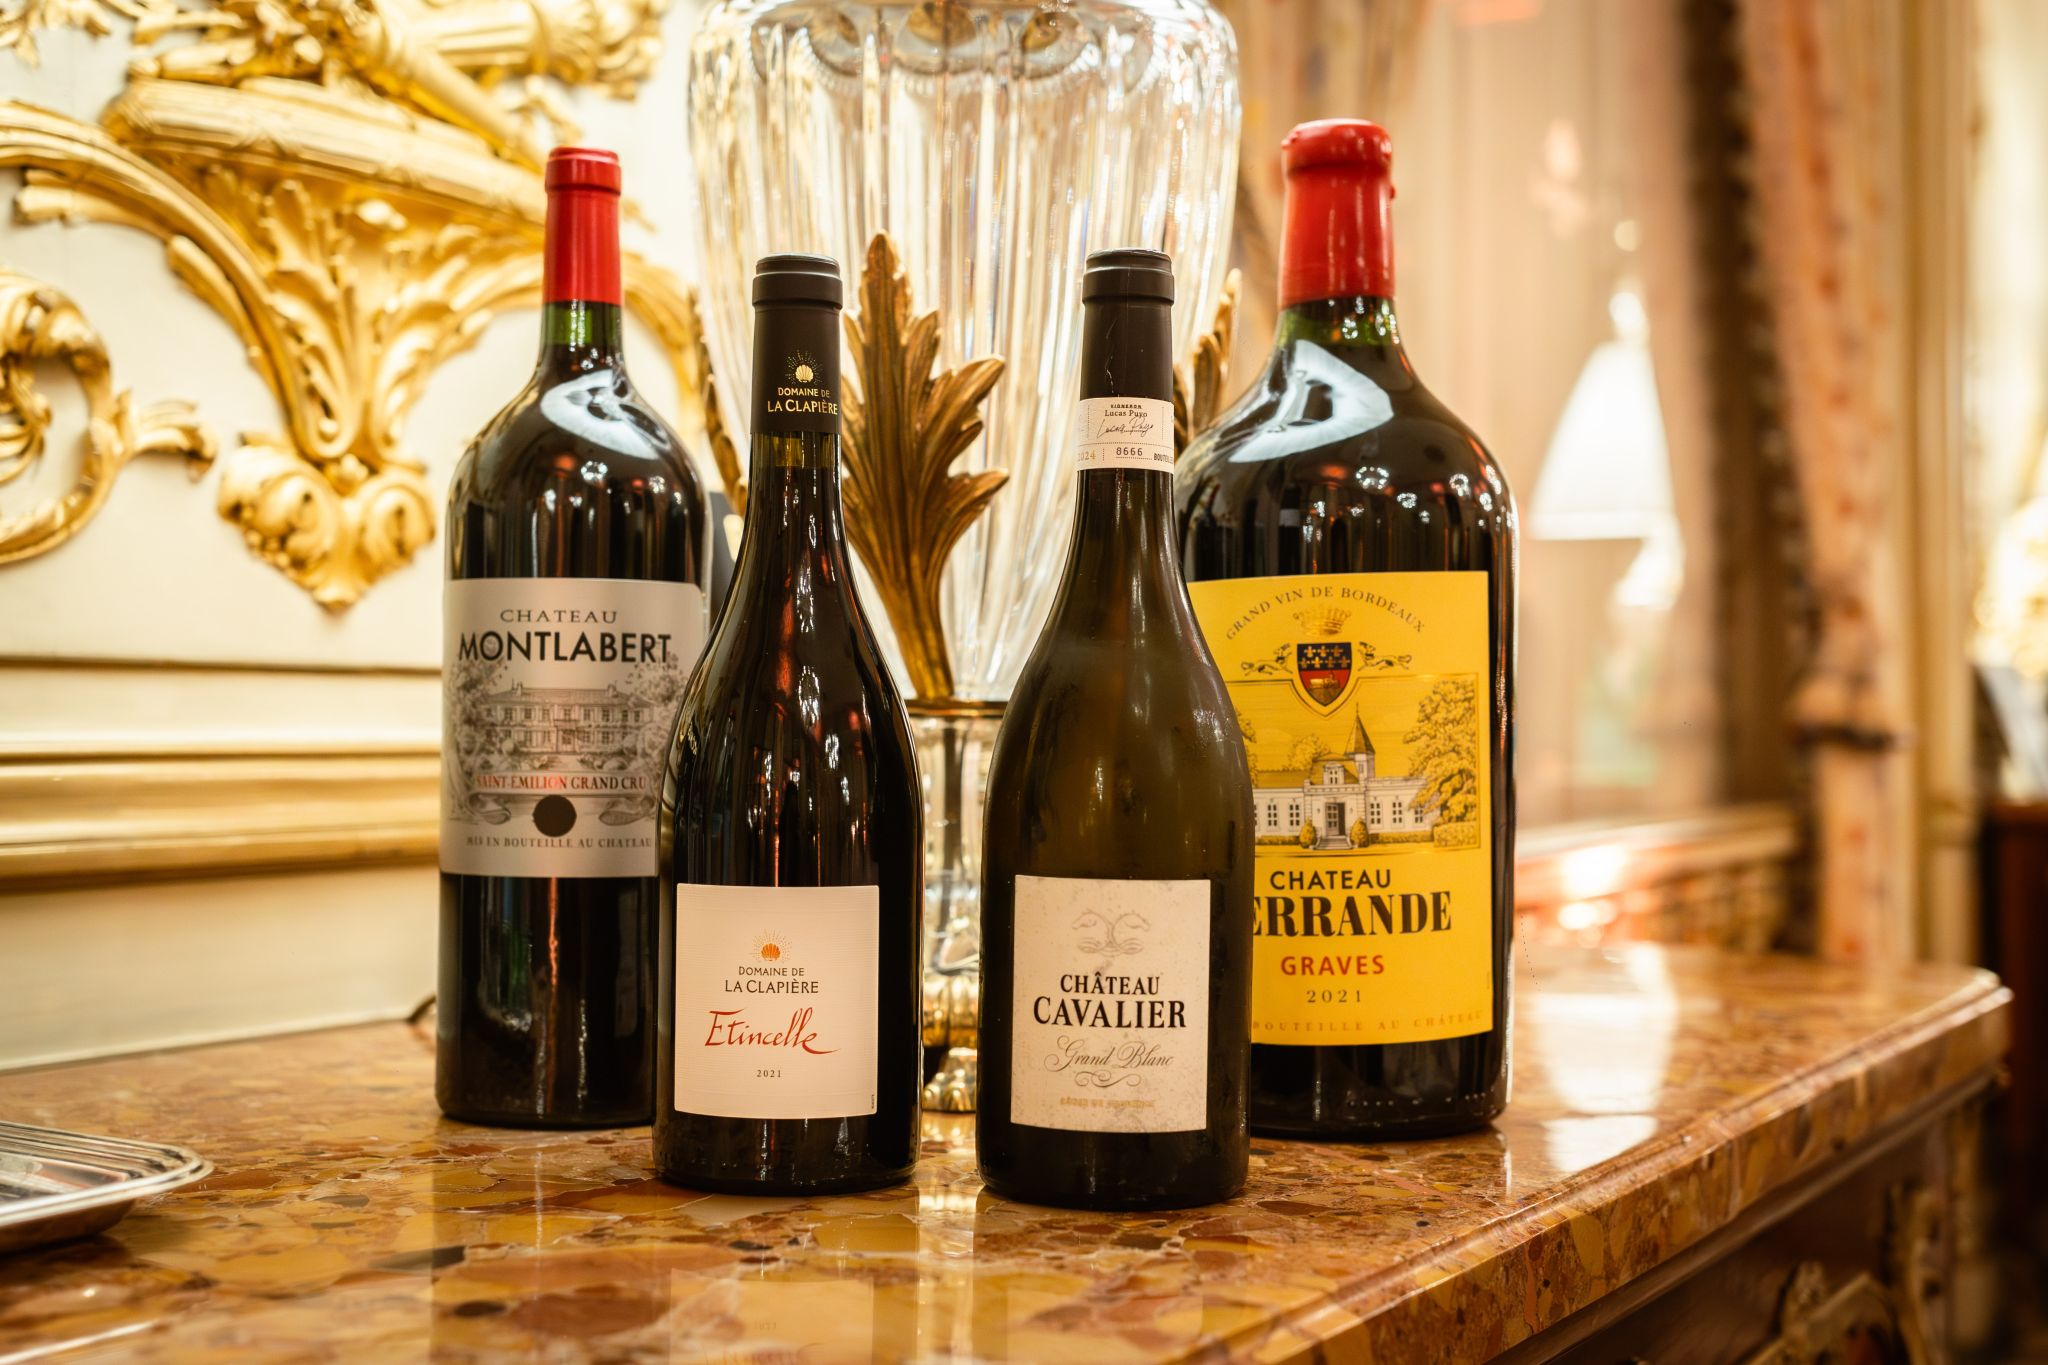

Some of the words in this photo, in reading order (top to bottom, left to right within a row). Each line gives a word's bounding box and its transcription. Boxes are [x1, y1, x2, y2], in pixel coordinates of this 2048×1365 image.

[778, 387, 819, 397] DOMAINE
[821, 389, 830, 398] DE
[768, 401, 783, 412] LA
[785, 399, 838, 415] CLAPIÈRE
[1129, 410, 1148, 419] Puyo
[1116, 447, 1143, 456] 8666
[500, 609, 618, 624] CHATEAU
[1226, 600, 1272, 641] GRAND
[1275, 588, 1303, 604] VIN
[1311, 586, 1334, 598] DE
[1341, 587, 1425, 633] BORDEAUX
[459, 630, 672, 663] MONTLABERT
[571, 775, 618, 790] GRAND
[621, 776, 646, 790] CRU
[487, 836, 500, 847] EN
[504, 837, 574, 848] BOUTEILLE
[576, 837, 595, 848] AU
[1270, 869, 1391, 890] CHATEAU
[738, 966, 788, 977] DOMAINE
[791, 967, 805, 977] DE
[1280, 955, 1385, 976] GRAVES
[725, 980, 743, 993] LA
[746, 978, 819, 994] CLAPIÈRE
[1060, 971, 1160, 995] CHÂTEAU
[1306, 989, 1362, 1003] 2021
[1033, 995, 1187, 1029] CAVALIER
[704, 1006, 842, 1055] Etincelle
[1378, 1022, 1400, 1030] AU
[1043, 1035, 1116, 1073] Grand
[1111, 1041, 1174, 1069] Blanc
[756, 1069, 782, 1078] 2021
